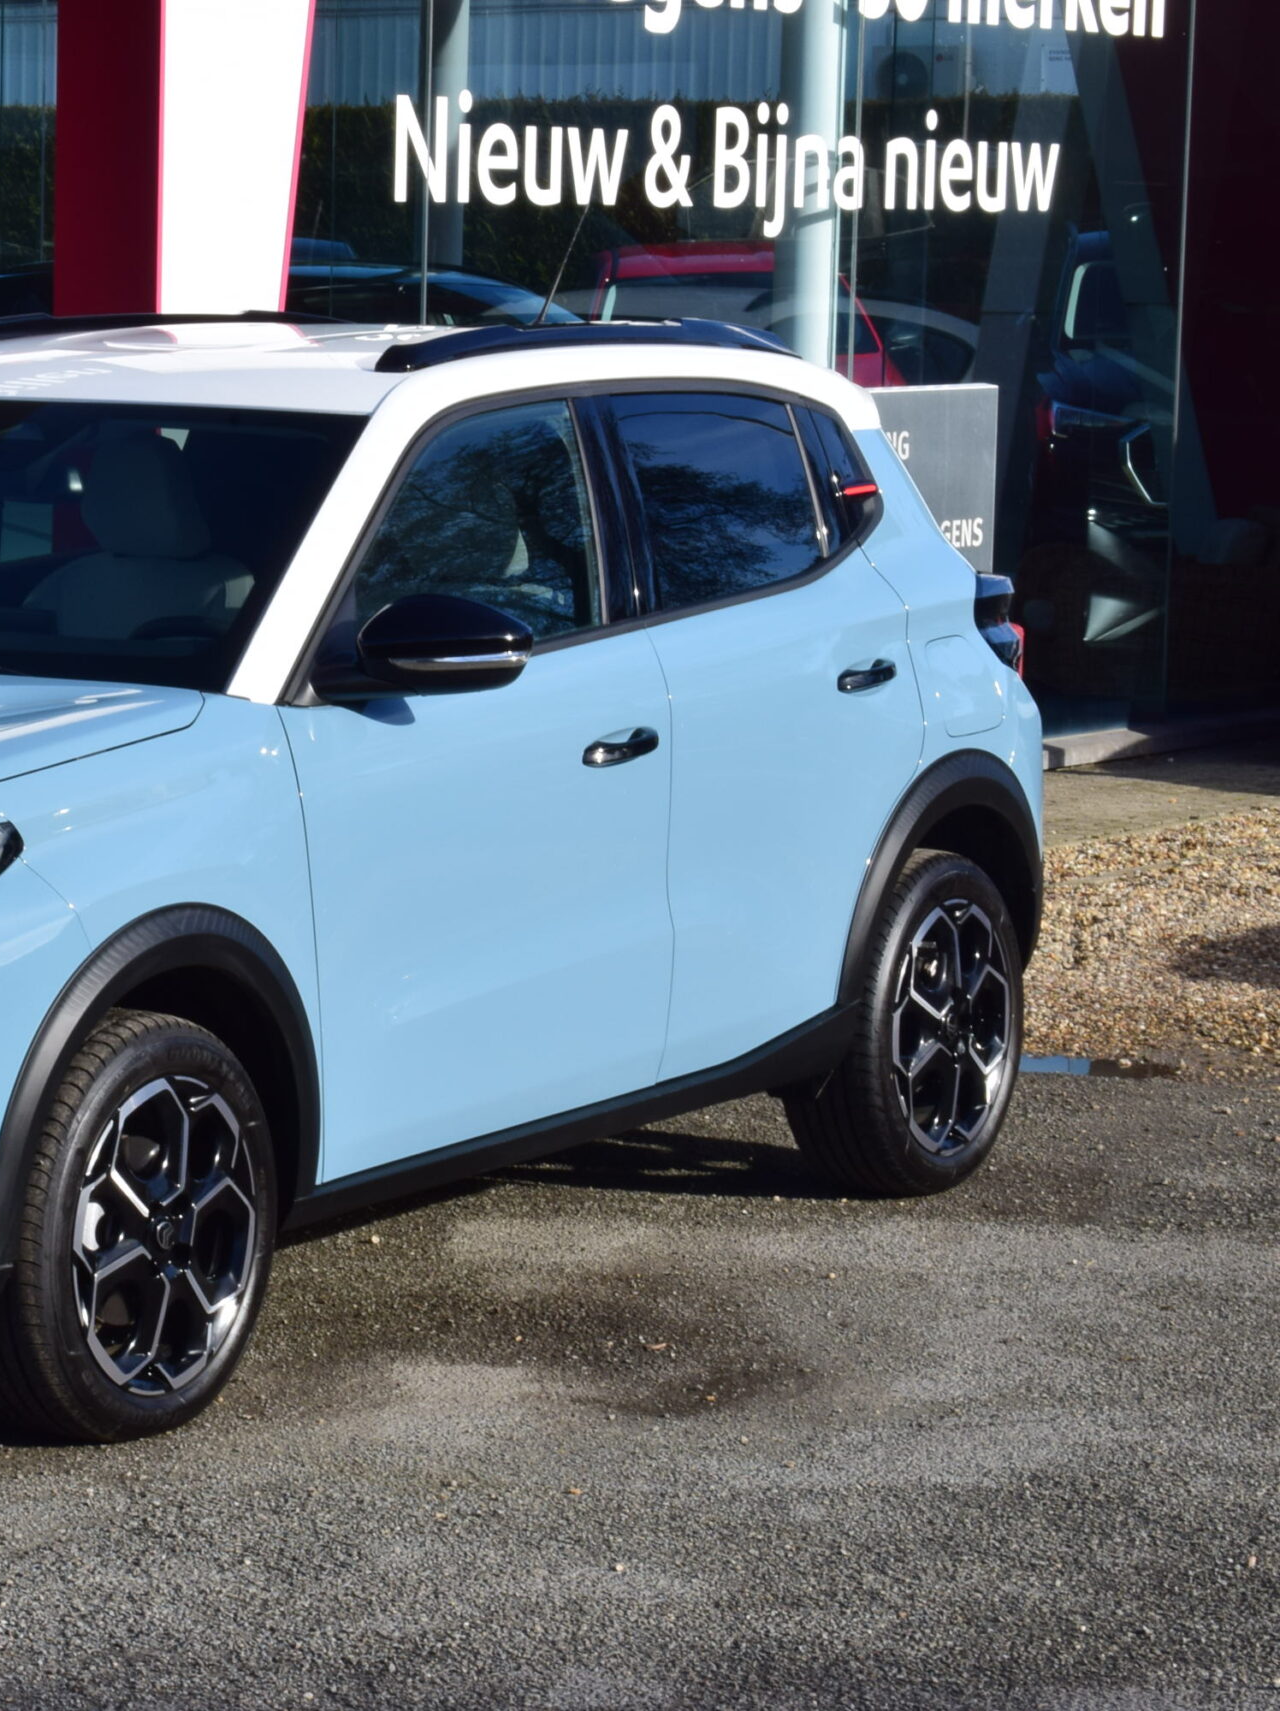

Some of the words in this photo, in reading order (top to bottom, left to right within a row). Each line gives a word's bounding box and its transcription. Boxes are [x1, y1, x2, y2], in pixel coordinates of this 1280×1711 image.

[394, 89, 629, 206] Nieuw
[644, 104, 704, 209] &
[713, 101, 865, 238] Bijna
[884, 108, 1060, 213] nieuw
[940, 517, 984, 547] GENS
